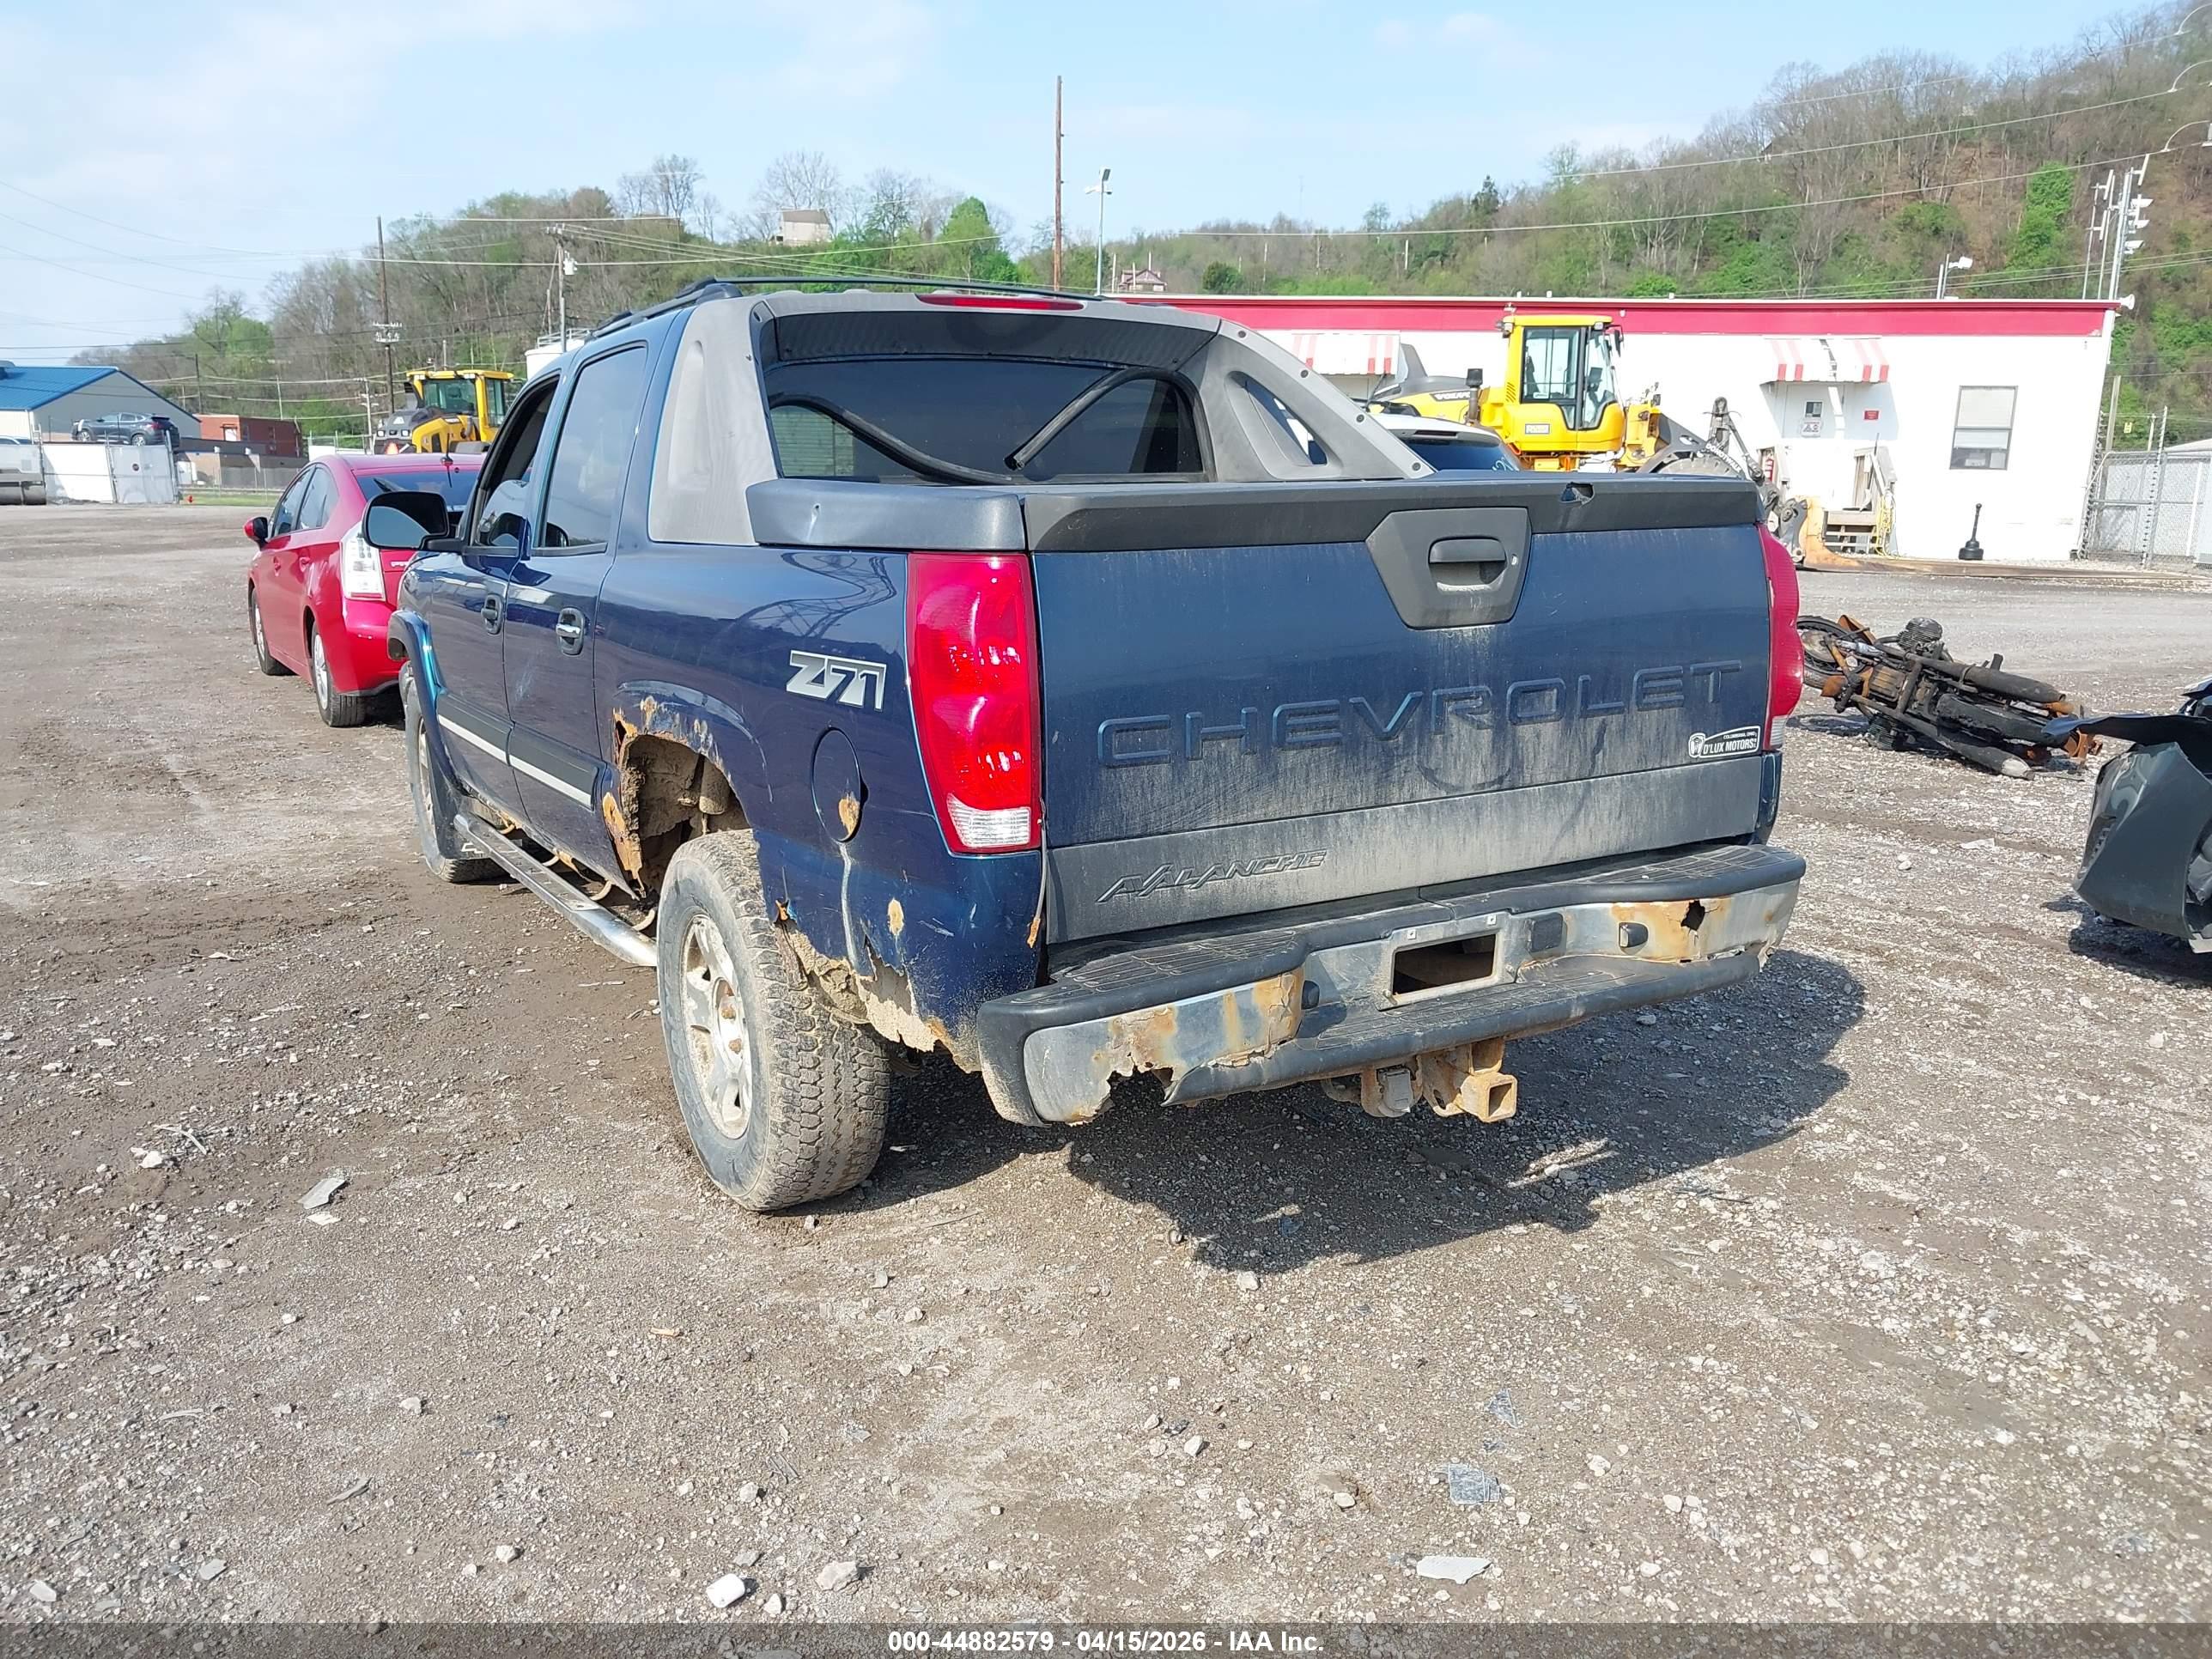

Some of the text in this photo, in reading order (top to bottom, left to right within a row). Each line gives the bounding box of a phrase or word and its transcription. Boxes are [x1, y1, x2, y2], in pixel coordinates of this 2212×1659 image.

[786, 650, 886, 712] Z71
[1097, 659, 1742, 769] CHEVROLET
[1725, 738, 1753, 752] MOTORS
[1096, 848, 1328, 904] AVALANCHE
